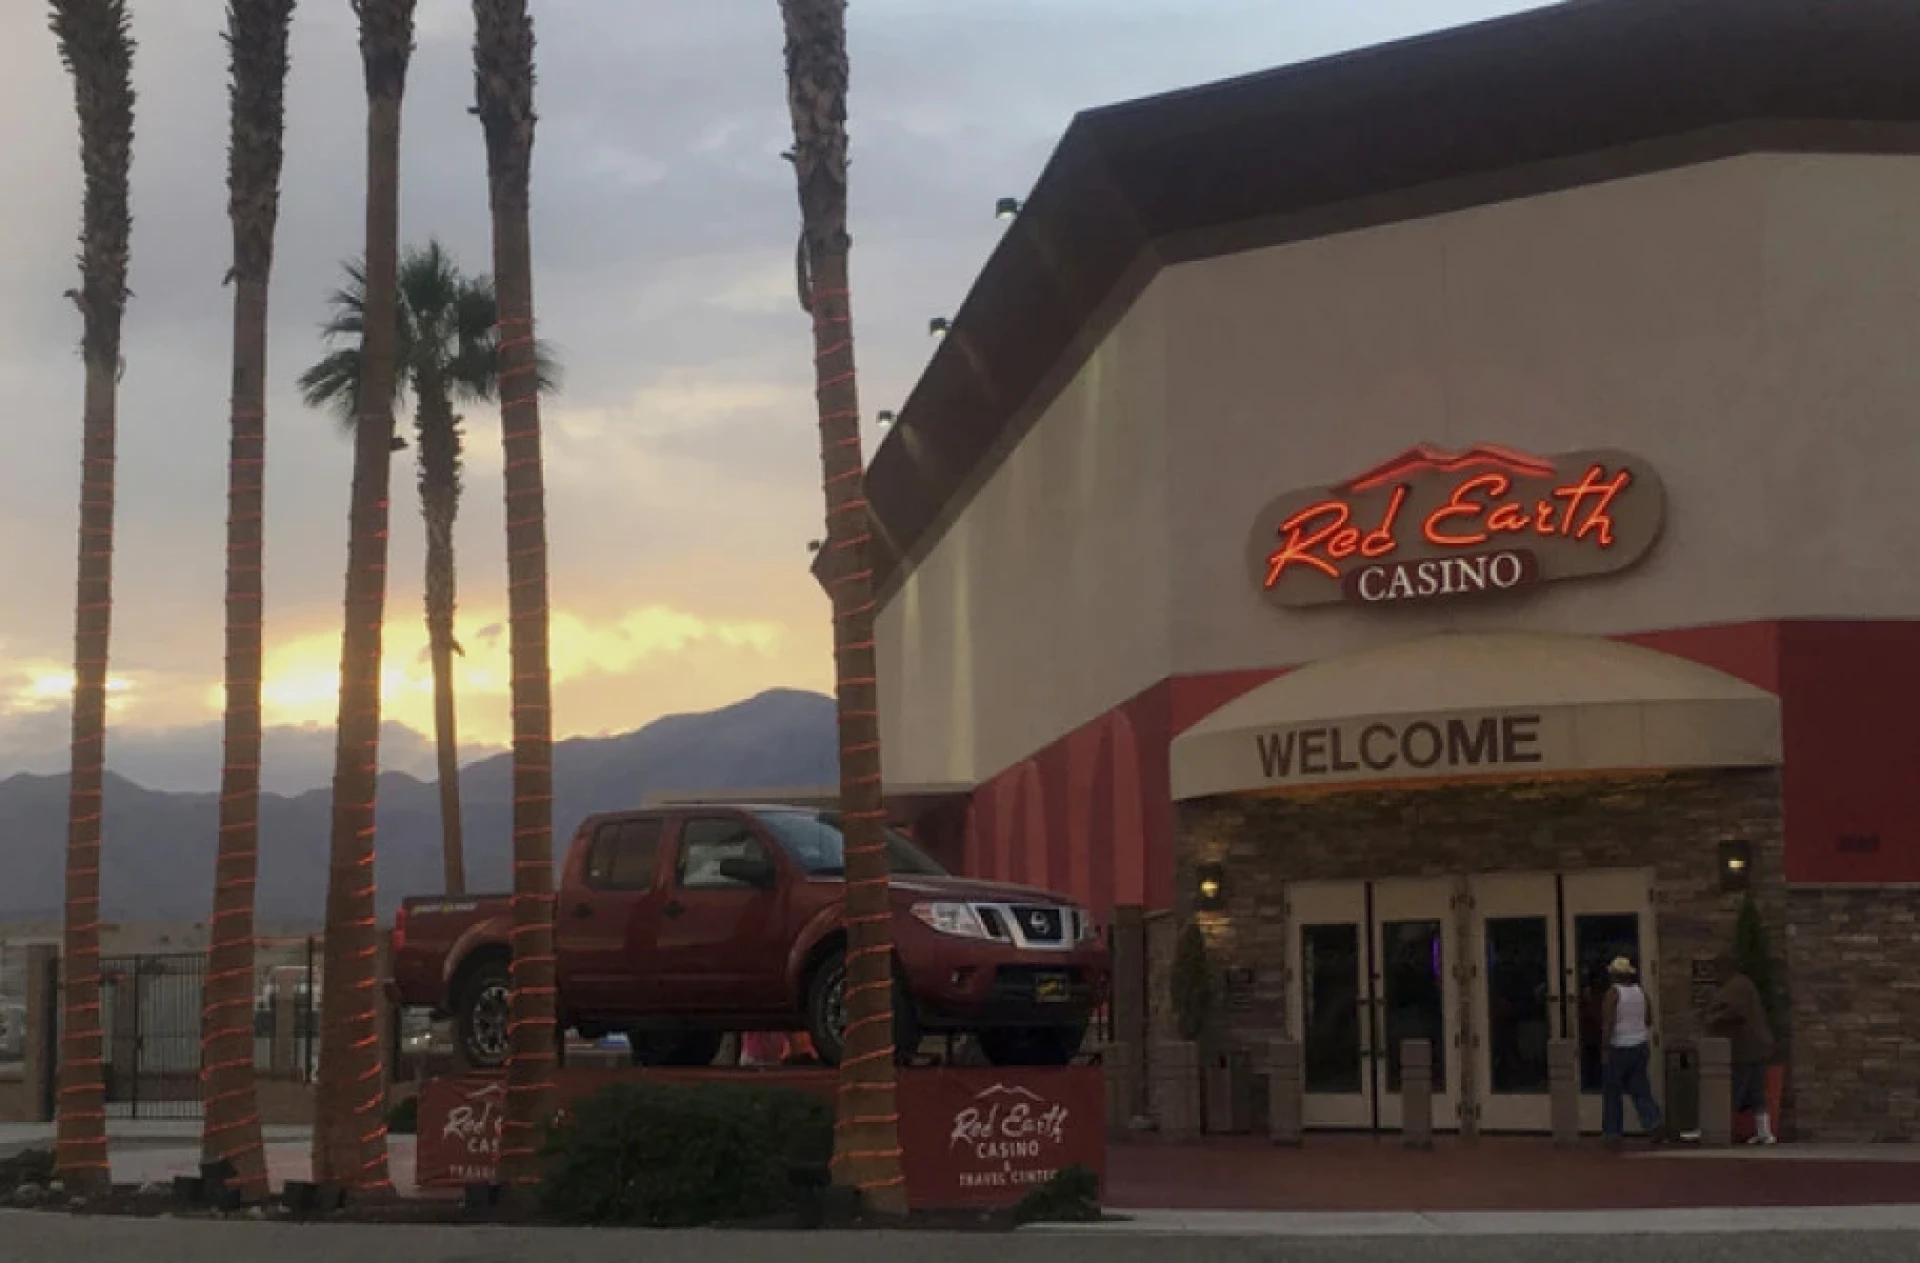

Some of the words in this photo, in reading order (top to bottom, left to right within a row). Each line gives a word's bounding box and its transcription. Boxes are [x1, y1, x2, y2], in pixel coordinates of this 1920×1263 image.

[1263, 486, 1409, 590] Red
[1422, 463, 1631, 550] Earth
[1357, 552, 1524, 602] CASINO
[1255, 714, 1542, 778] WELCOME
[951, 1103, 1000, 1147] Red
[1001, 1102, 1069, 1144] Earth
[976, 1140, 1040, 1159] CASINO
